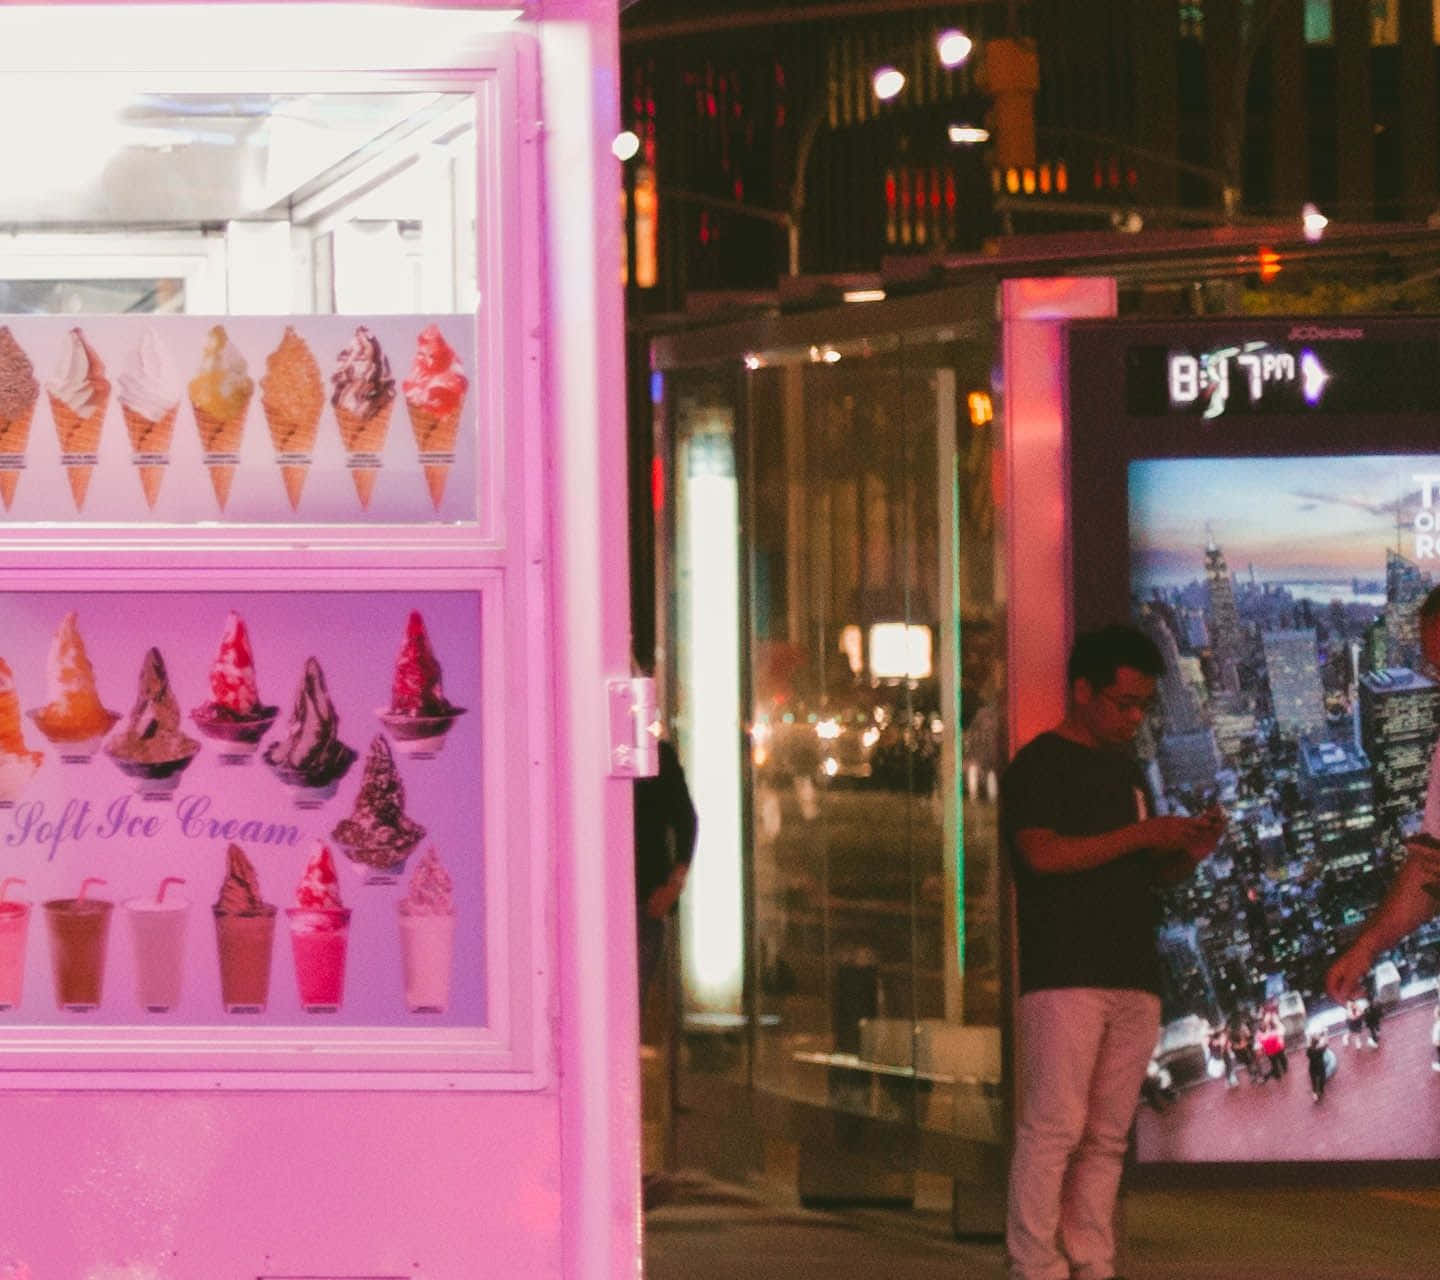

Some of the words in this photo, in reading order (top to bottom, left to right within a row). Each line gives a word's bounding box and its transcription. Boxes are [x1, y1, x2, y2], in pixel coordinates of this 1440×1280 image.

[5, 799, 92, 862] Soft
[97, 795, 160, 839] Ice
[176, 794, 300, 846] Cream
